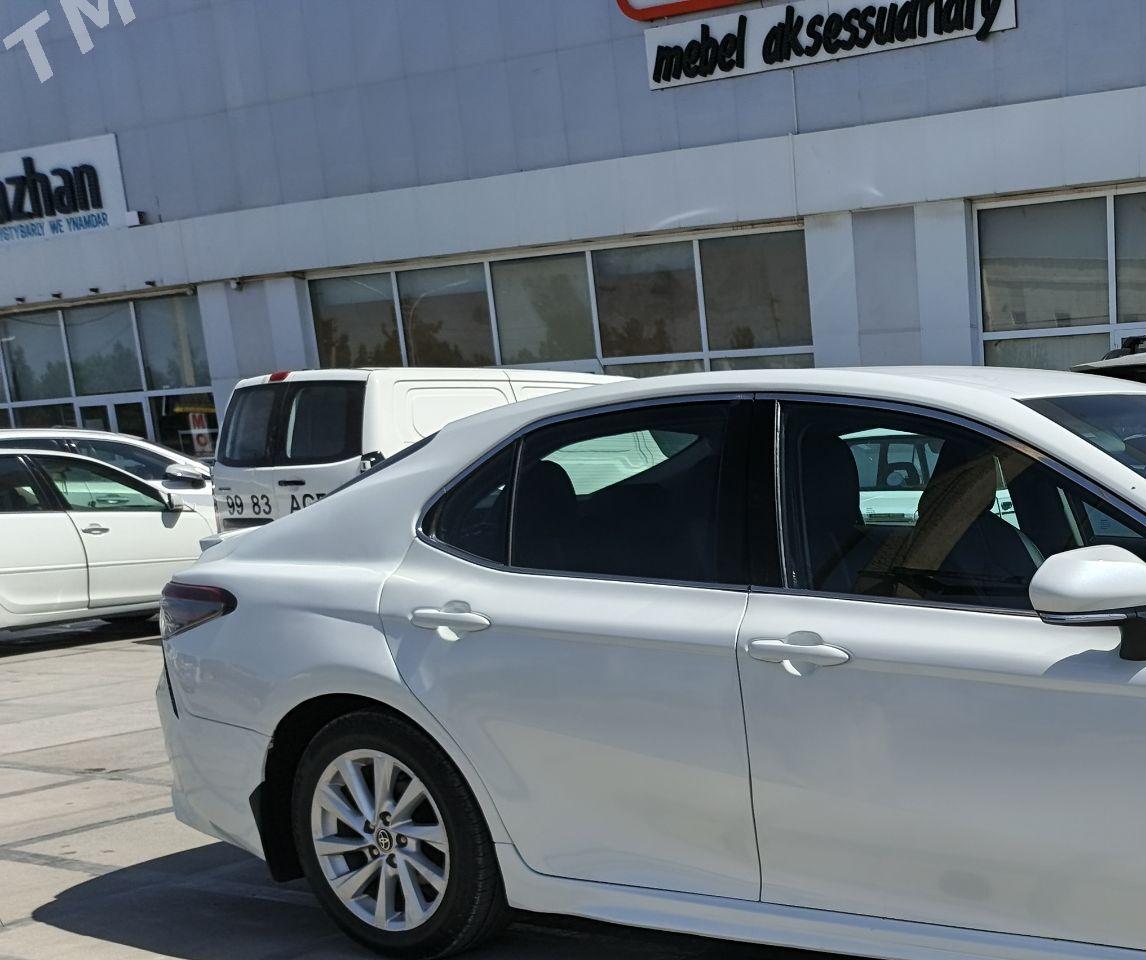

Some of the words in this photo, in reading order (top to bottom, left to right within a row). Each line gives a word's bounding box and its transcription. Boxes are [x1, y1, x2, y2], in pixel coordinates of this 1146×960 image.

[652, 14, 748, 84] mebel
[762, 0, 1001, 66] aksessuarlary
[49, 219, 64, 235] WE
[226, 494, 244, 516] 99
[251, 494, 272, 515] 83
